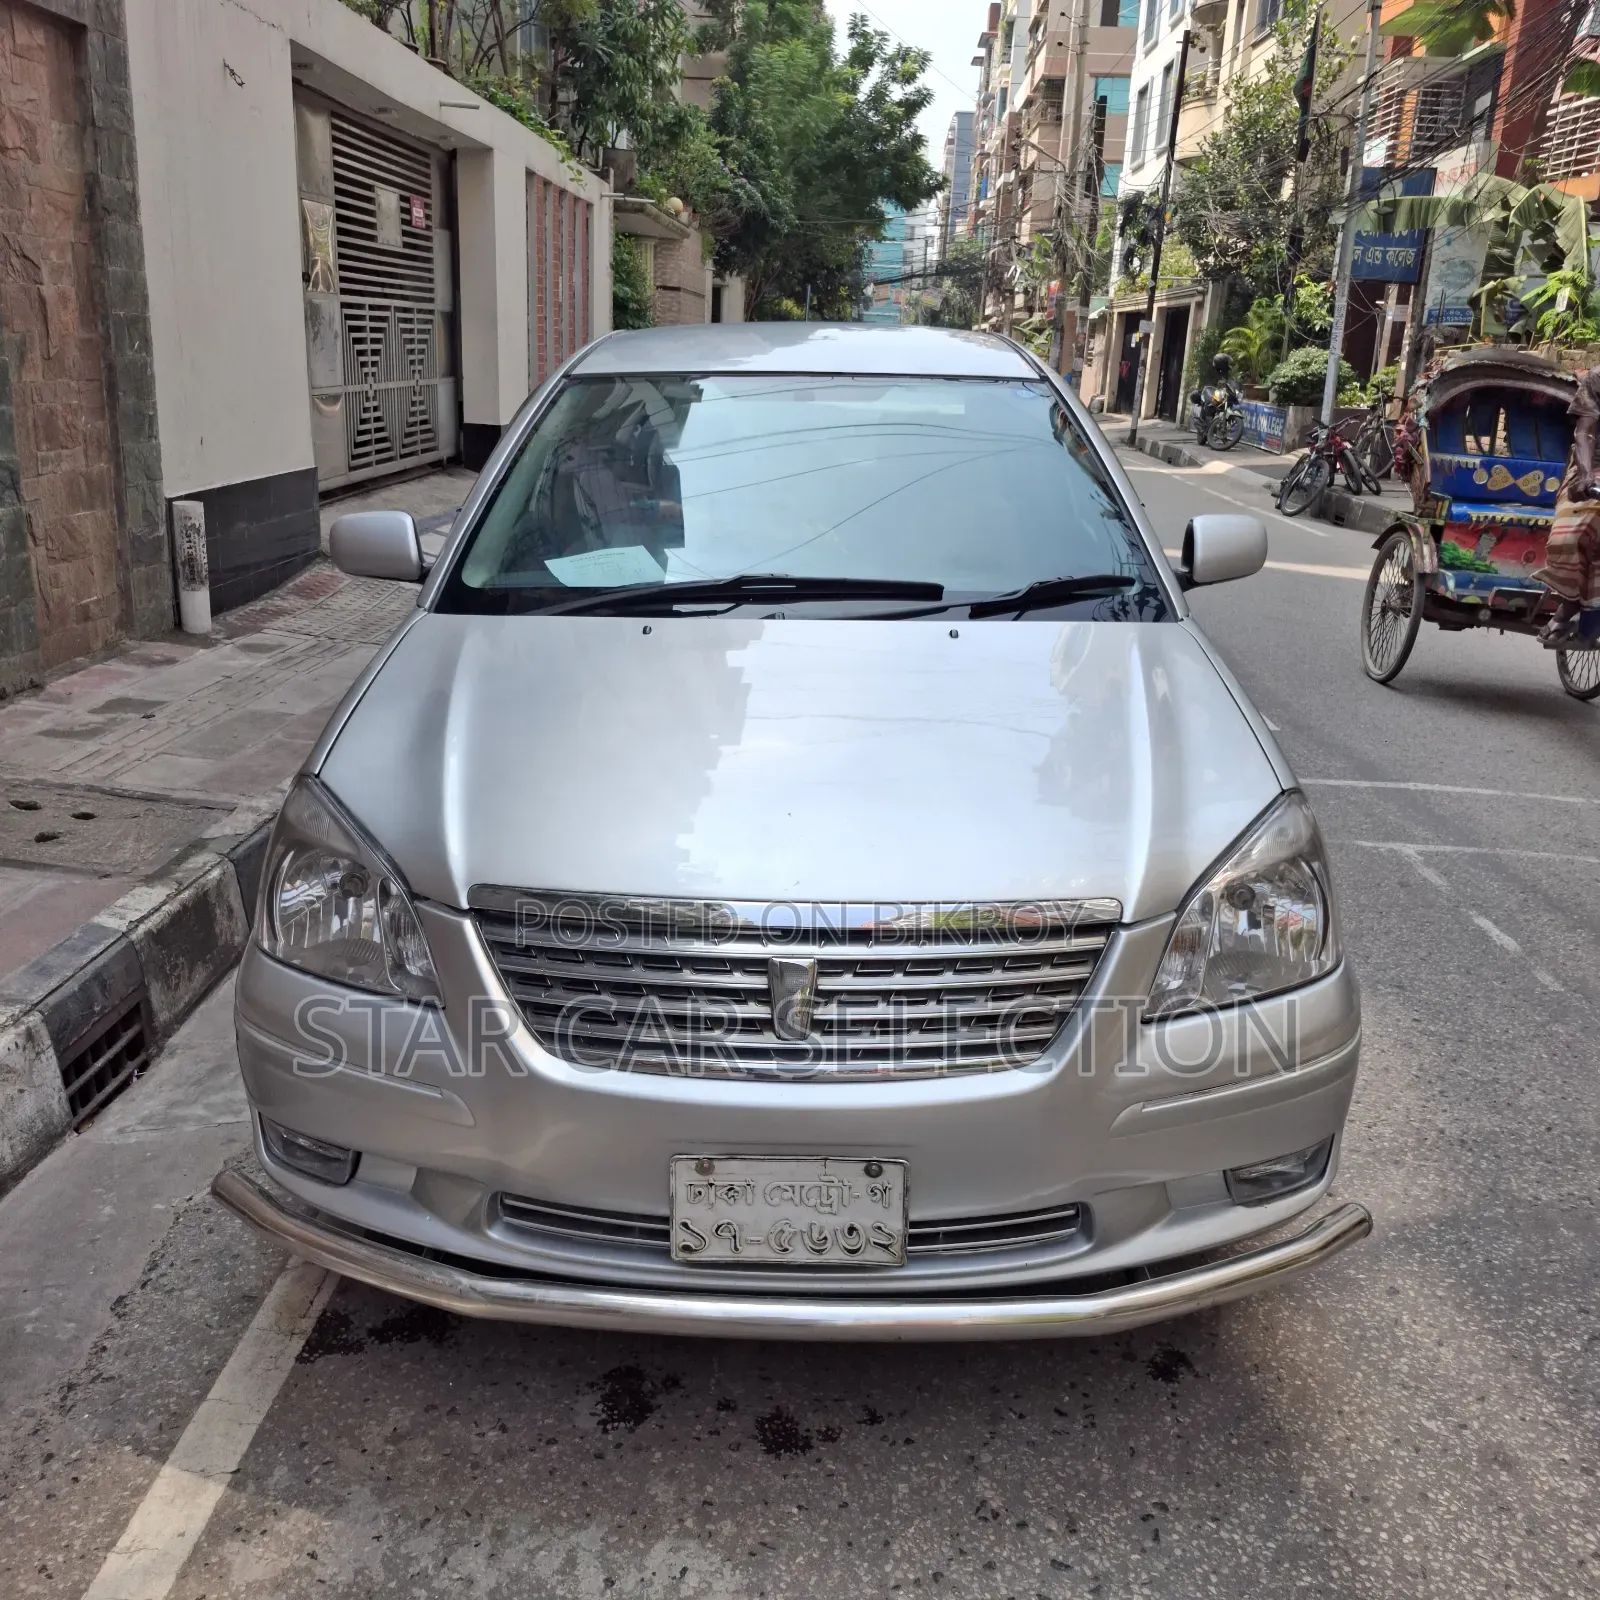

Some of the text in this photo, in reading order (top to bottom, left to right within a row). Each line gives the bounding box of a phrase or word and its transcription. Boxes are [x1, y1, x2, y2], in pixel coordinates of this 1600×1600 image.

[1386, 247, 1417, 268] কলেজ
[1257, 413, 1284, 436] COLLEGE
[685, 1177, 755, 1207] ঢাকা
[679, 1218, 898, 1258] ১৭-৫৬৩২
